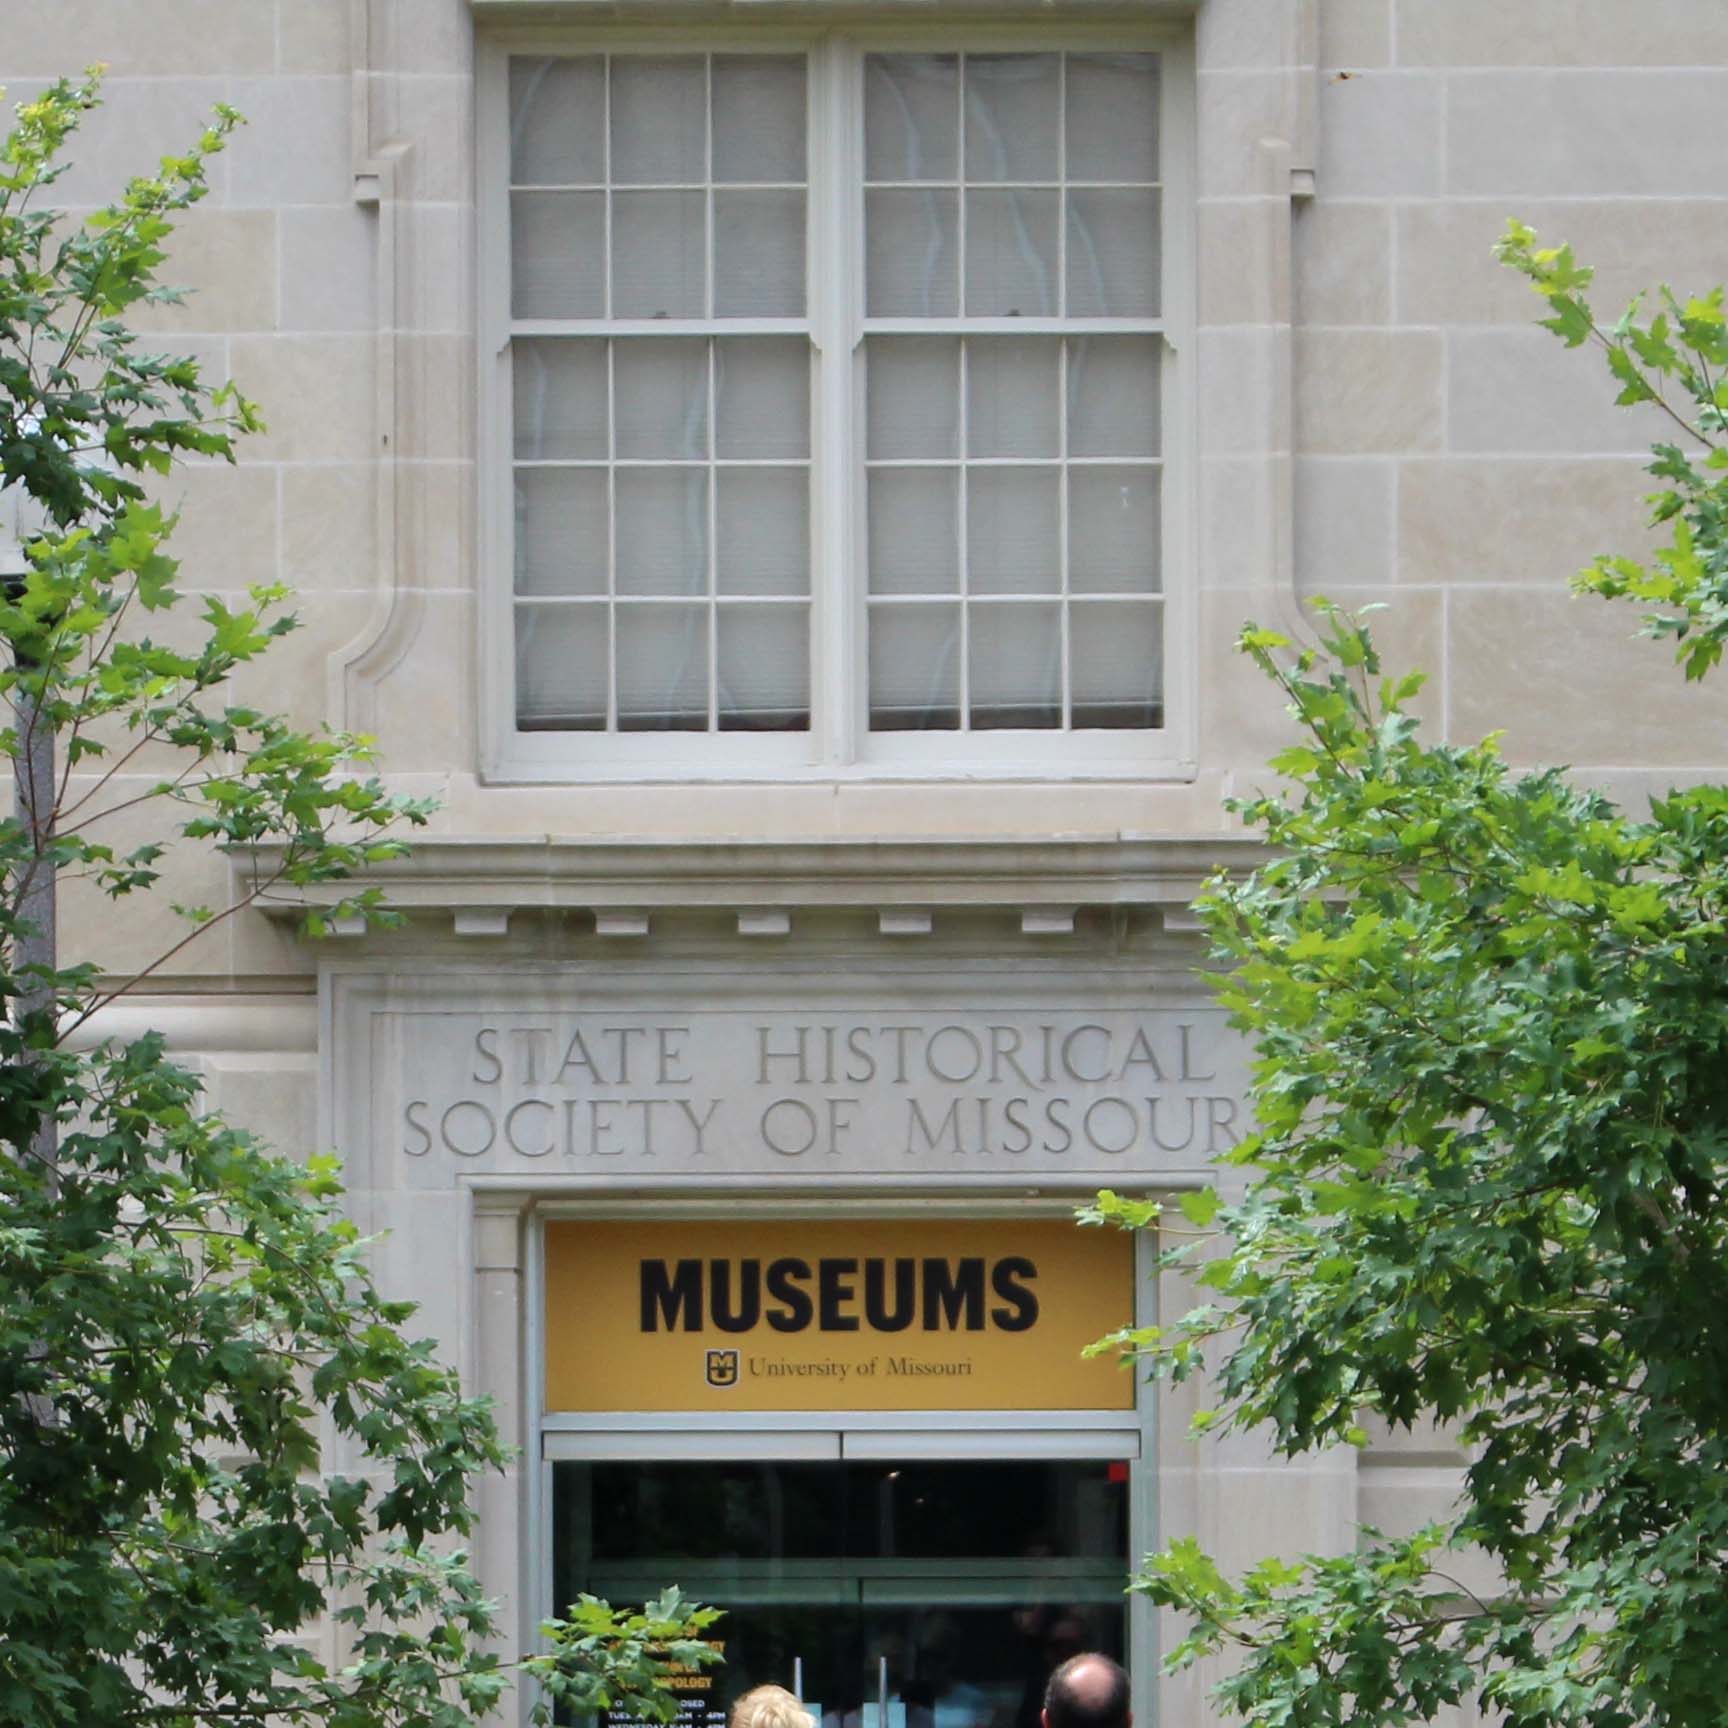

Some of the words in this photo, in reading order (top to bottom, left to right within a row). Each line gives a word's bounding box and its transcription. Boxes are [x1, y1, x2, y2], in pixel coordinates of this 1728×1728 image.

[472, 1027, 693, 1085] STATE
[755, 1024, 1217, 1091] HISTORICAL
[402, 1098, 721, 1157] SOCIETY
[760, 1097, 860, 1156] OF
[903, 1096, 1242, 1154] MISSOUR
[638, 1256, 1040, 1333] MUSEUMS
[748, 1356, 849, 1382] University
[856, 1356, 879, 1376] of
[887, 1356, 973, 1377] Missouri
